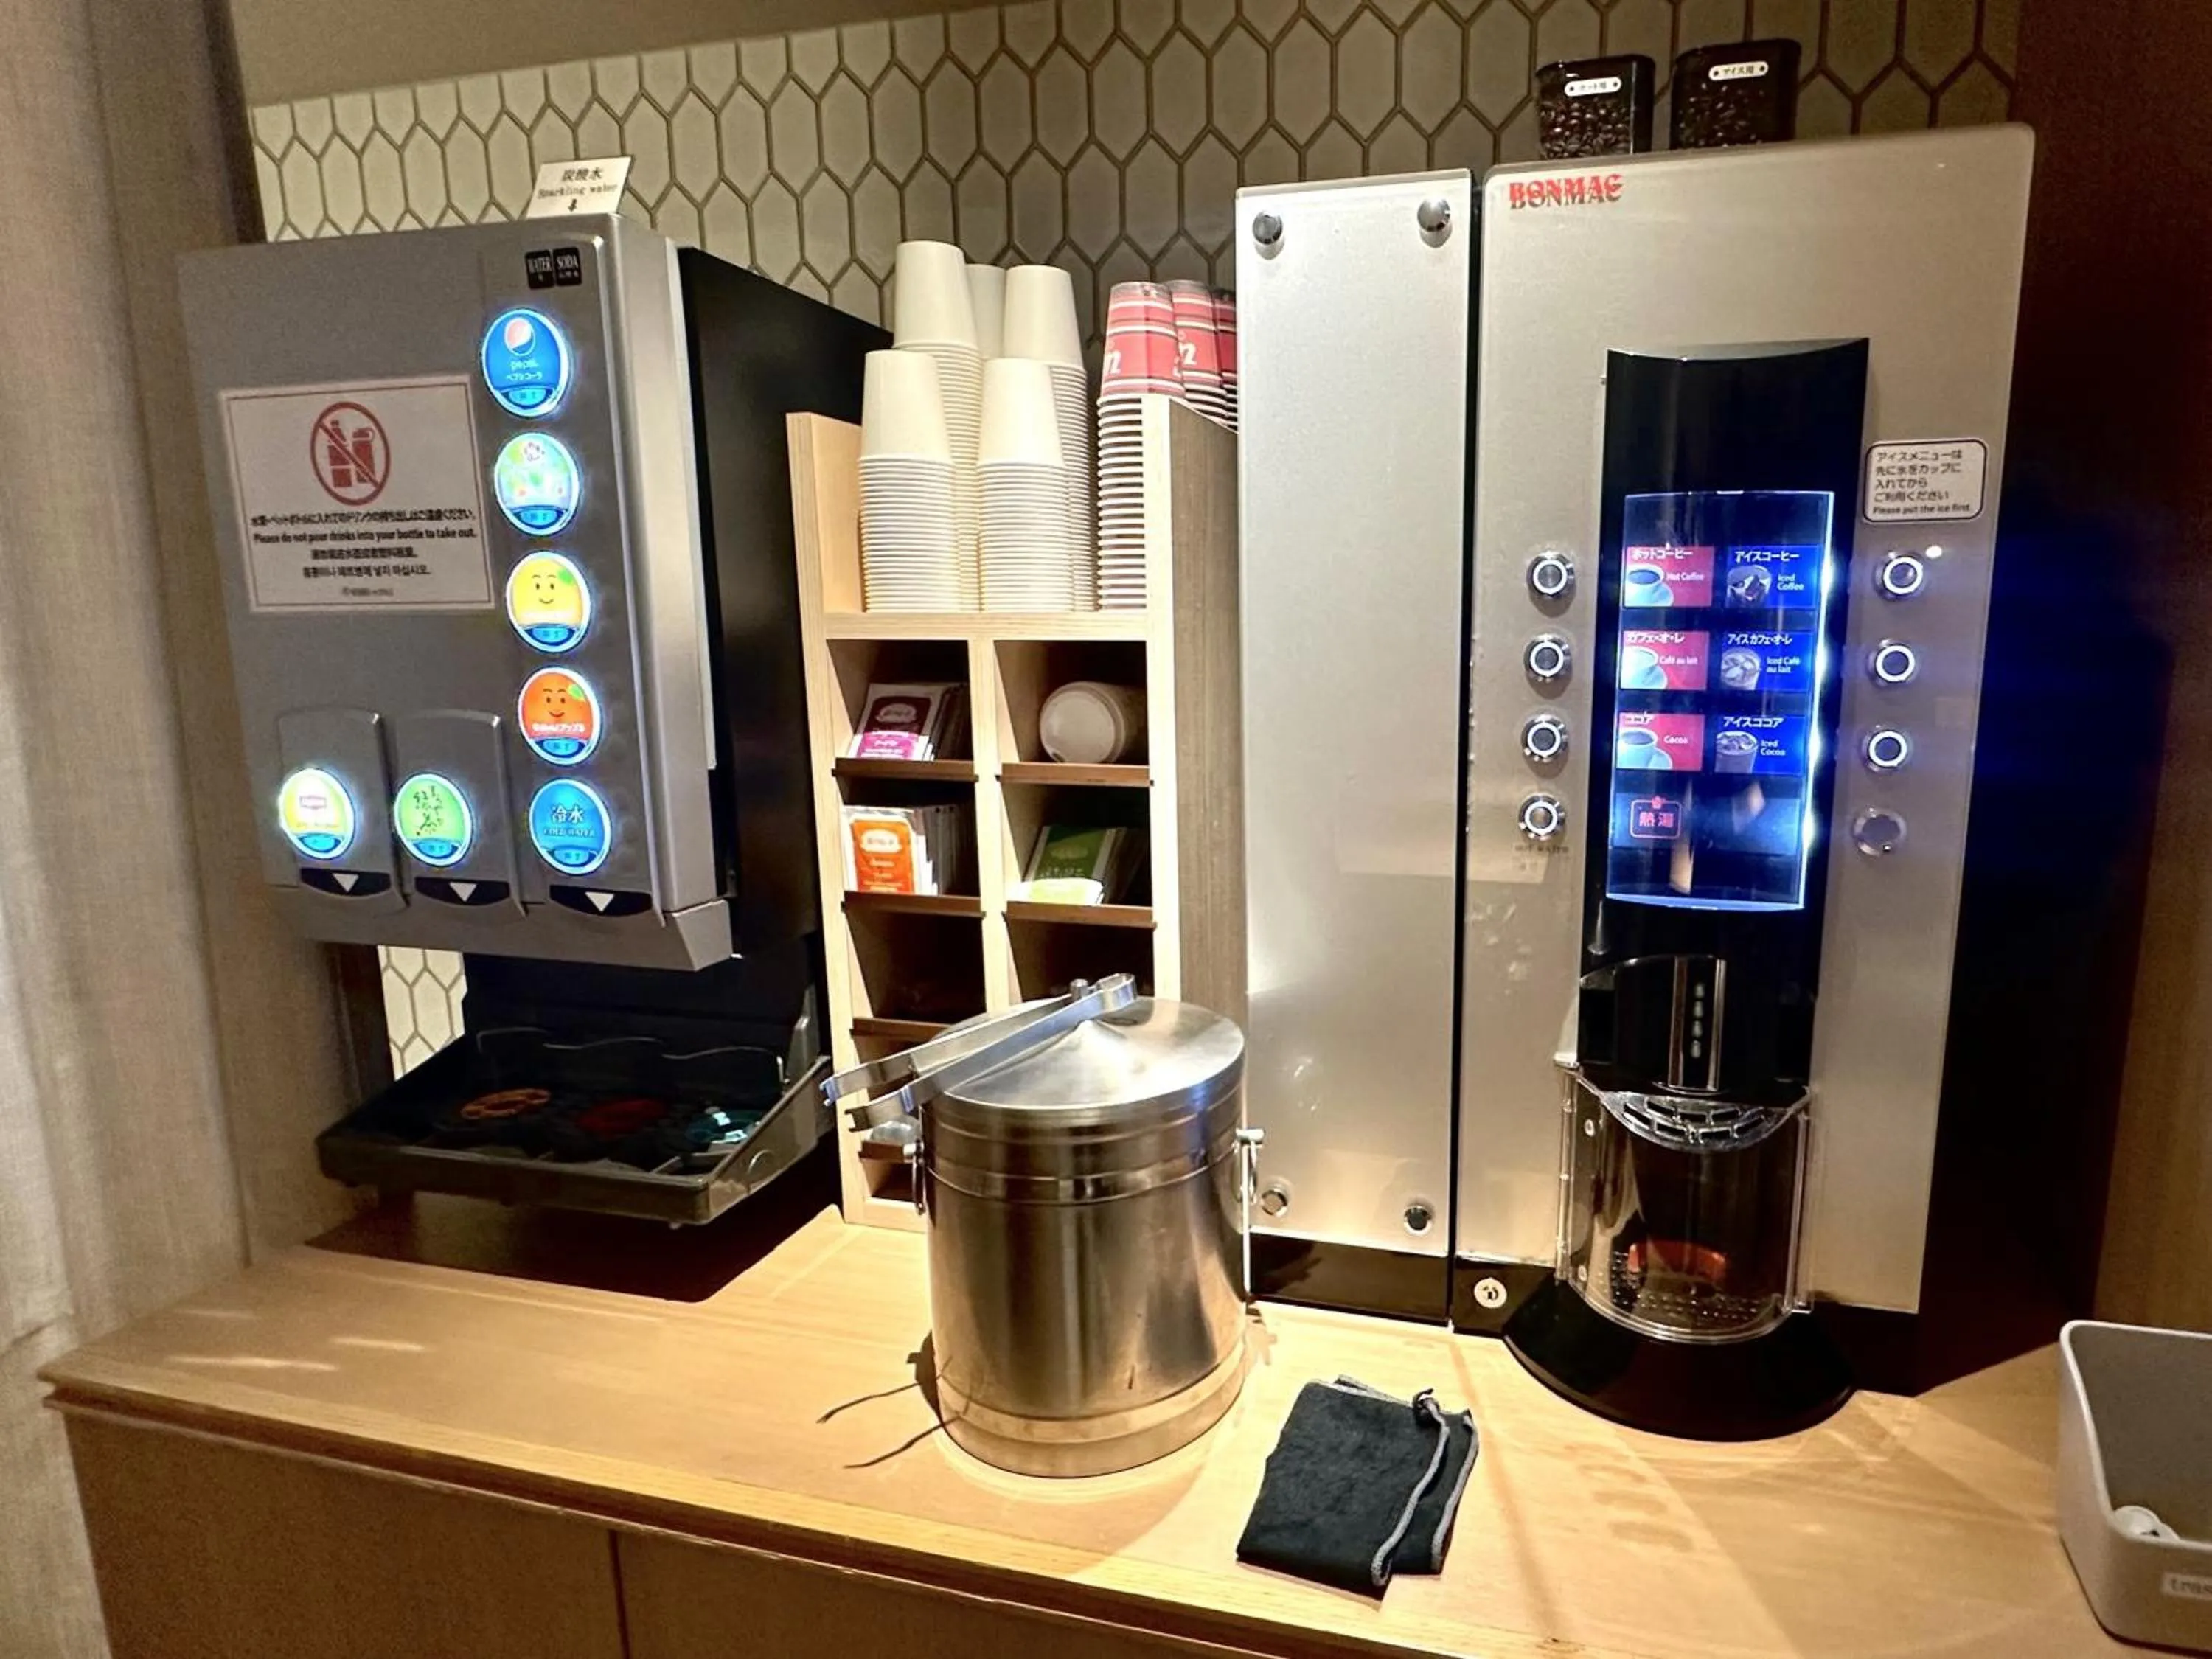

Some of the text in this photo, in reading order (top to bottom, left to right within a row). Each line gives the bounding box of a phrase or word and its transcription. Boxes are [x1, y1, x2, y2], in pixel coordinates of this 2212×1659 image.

[1509, 174, 1624, 207] BONMAC
[1877, 449, 1963, 462] アイスメニューは
[1875, 477, 1927, 490] 入れてから
[1873, 506, 1900, 515] Please
[1902, 506, 1917, 515] put
[1920, 505, 1935, 514] the
[1937, 504, 1950, 512] ice
[254, 533, 279, 543] Please
[282, 532, 291, 542] do
[293, 532, 307, 542] not
[308, 533, 327, 544] pour
[330, 530, 355, 540] drinks
[376, 532, 395, 542] your
[397, 529, 423, 538] bottle
[425, 529, 434, 538] to
[437, 527, 456, 538] take
[1734, 550, 1800, 563] アイスコーヒー
[1665, 572, 1704, 581] Hot Coffee
[1778, 573, 1795, 582] Iced
[1777, 582, 1804, 591] Coffee
[1767, 657, 1781, 665] Iced
[1723, 715, 1784, 728] アイスココア
[1663, 735, 1689, 744] Cocoa
[1761, 739, 1778, 748] Iced
[1761, 747, 1786, 757] Cocoa
[552, 804, 585, 824] 冷水
